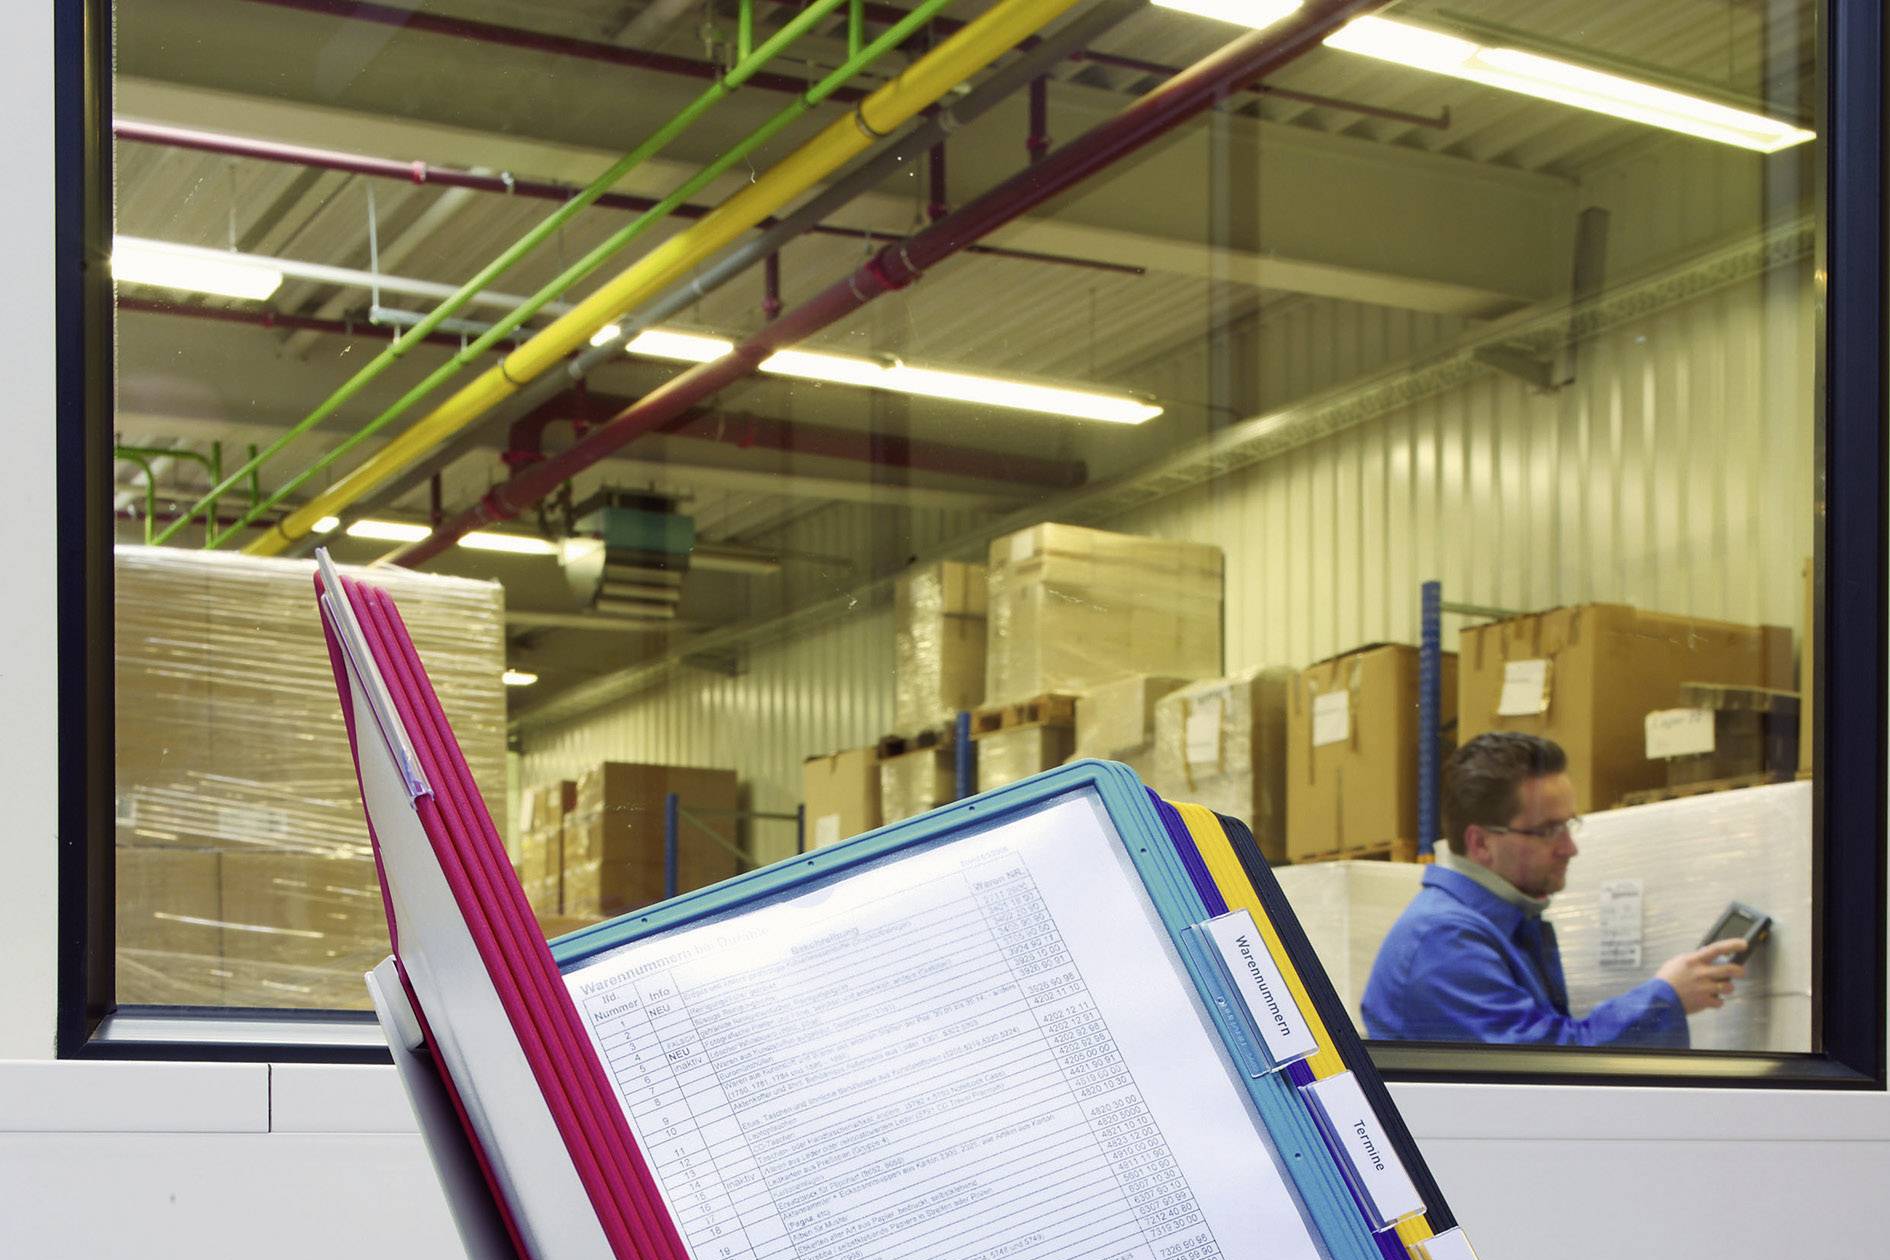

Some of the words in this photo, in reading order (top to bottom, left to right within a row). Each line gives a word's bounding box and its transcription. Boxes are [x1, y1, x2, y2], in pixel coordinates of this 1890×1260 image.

[1235, 934, 1290, 1036] Warennummern
[648, 988, 671, 1002] Info
[594, 999, 638, 1022] Nummer
[648, 1004, 671, 1018] NEU
[668, 1047, 691, 1062] NEU
[1353, 1119, 1384, 1171] Termine
